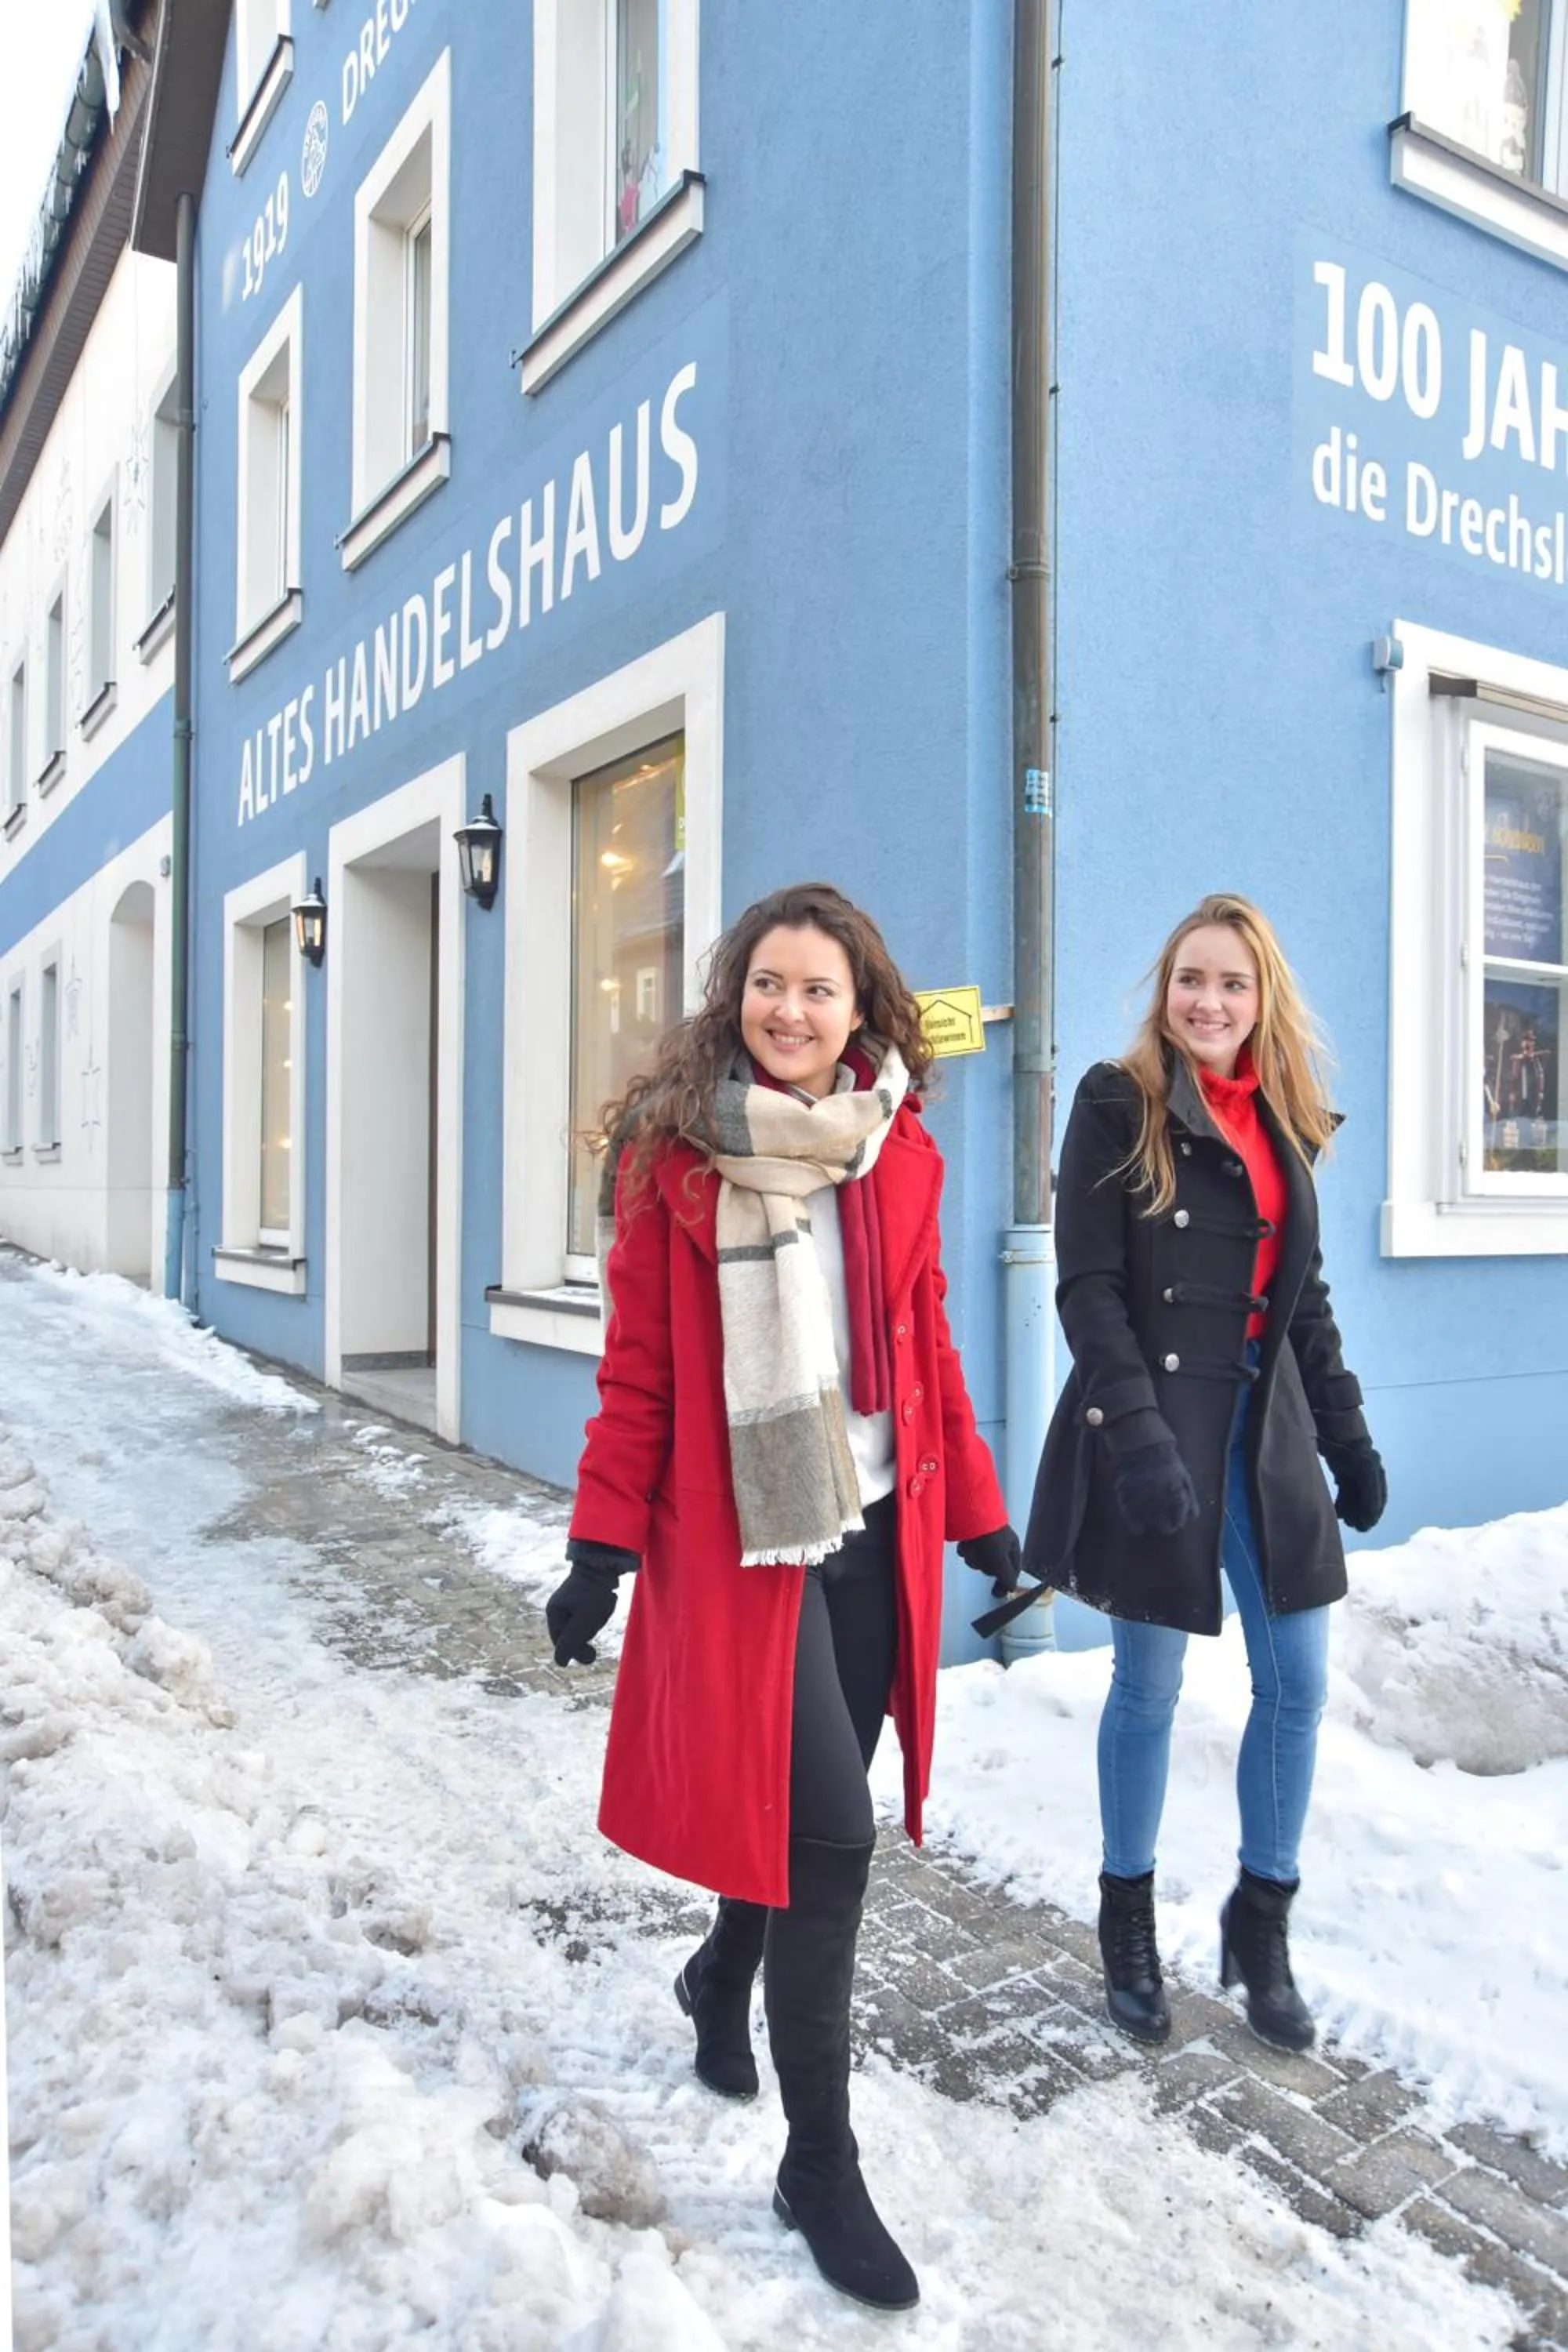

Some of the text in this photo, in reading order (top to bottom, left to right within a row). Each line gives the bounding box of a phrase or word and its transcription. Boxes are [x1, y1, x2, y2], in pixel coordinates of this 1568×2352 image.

[242, 0, 416, 301] 1919 DRE
[1312, 260, 1442, 419] 100
[238, 361, 698, 826] ALTES HANDELSHAUS
[1312, 426, 1568, 585] die Drechsl
